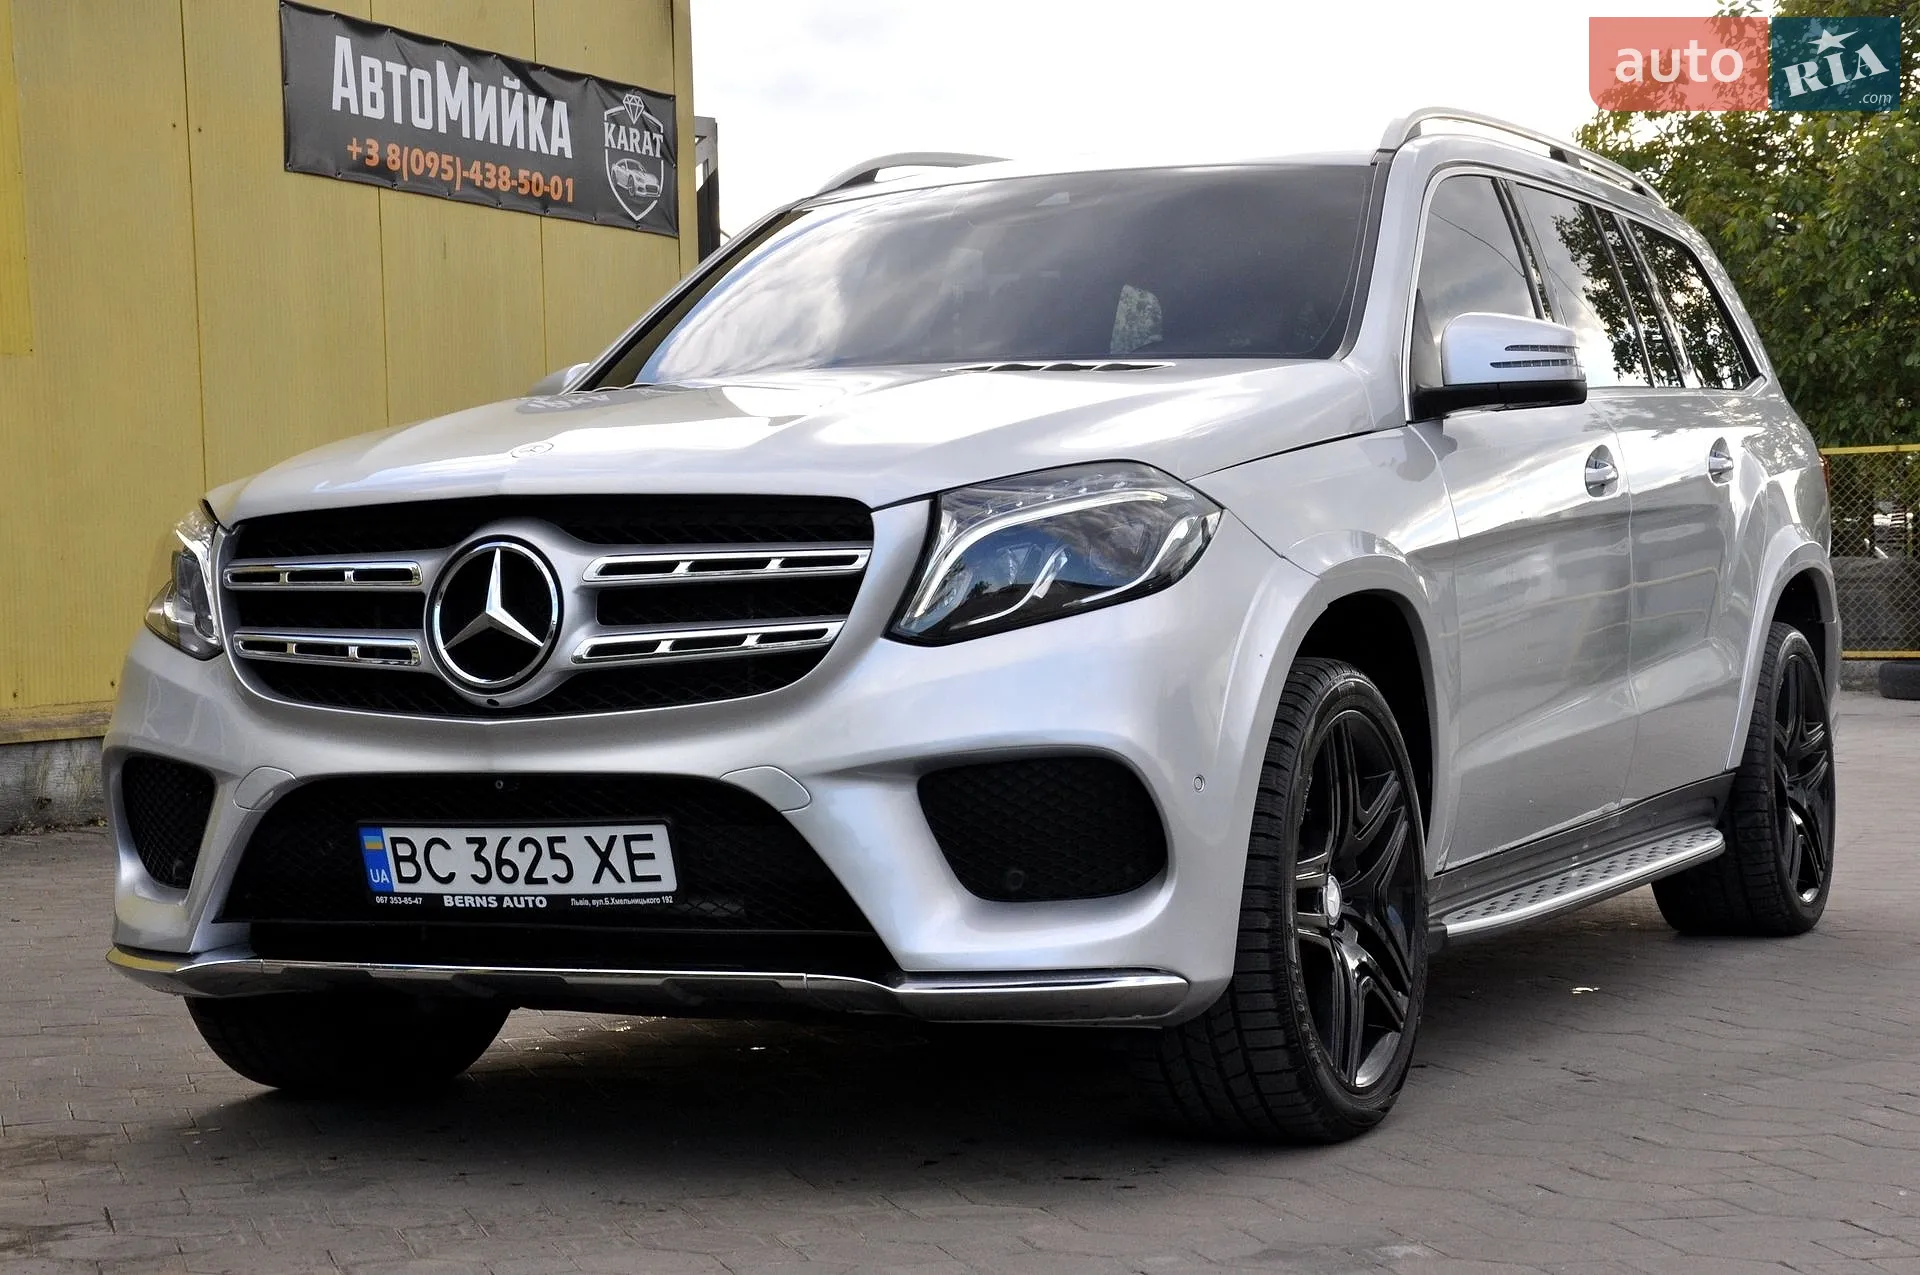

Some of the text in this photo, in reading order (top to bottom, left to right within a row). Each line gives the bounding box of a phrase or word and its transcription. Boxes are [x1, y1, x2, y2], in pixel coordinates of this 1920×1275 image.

[603, 121, 664, 159] KARAT
[387, 143, 574, 203] 8(095)-438-50-01
[389, 833, 662, 885] BC 3625 XE
[370, 868, 390, 884] UA
[375, 896, 388, 904] 067
[443, 895, 547, 908] BERNS AUTO
[661, 896, 673, 904] 192
